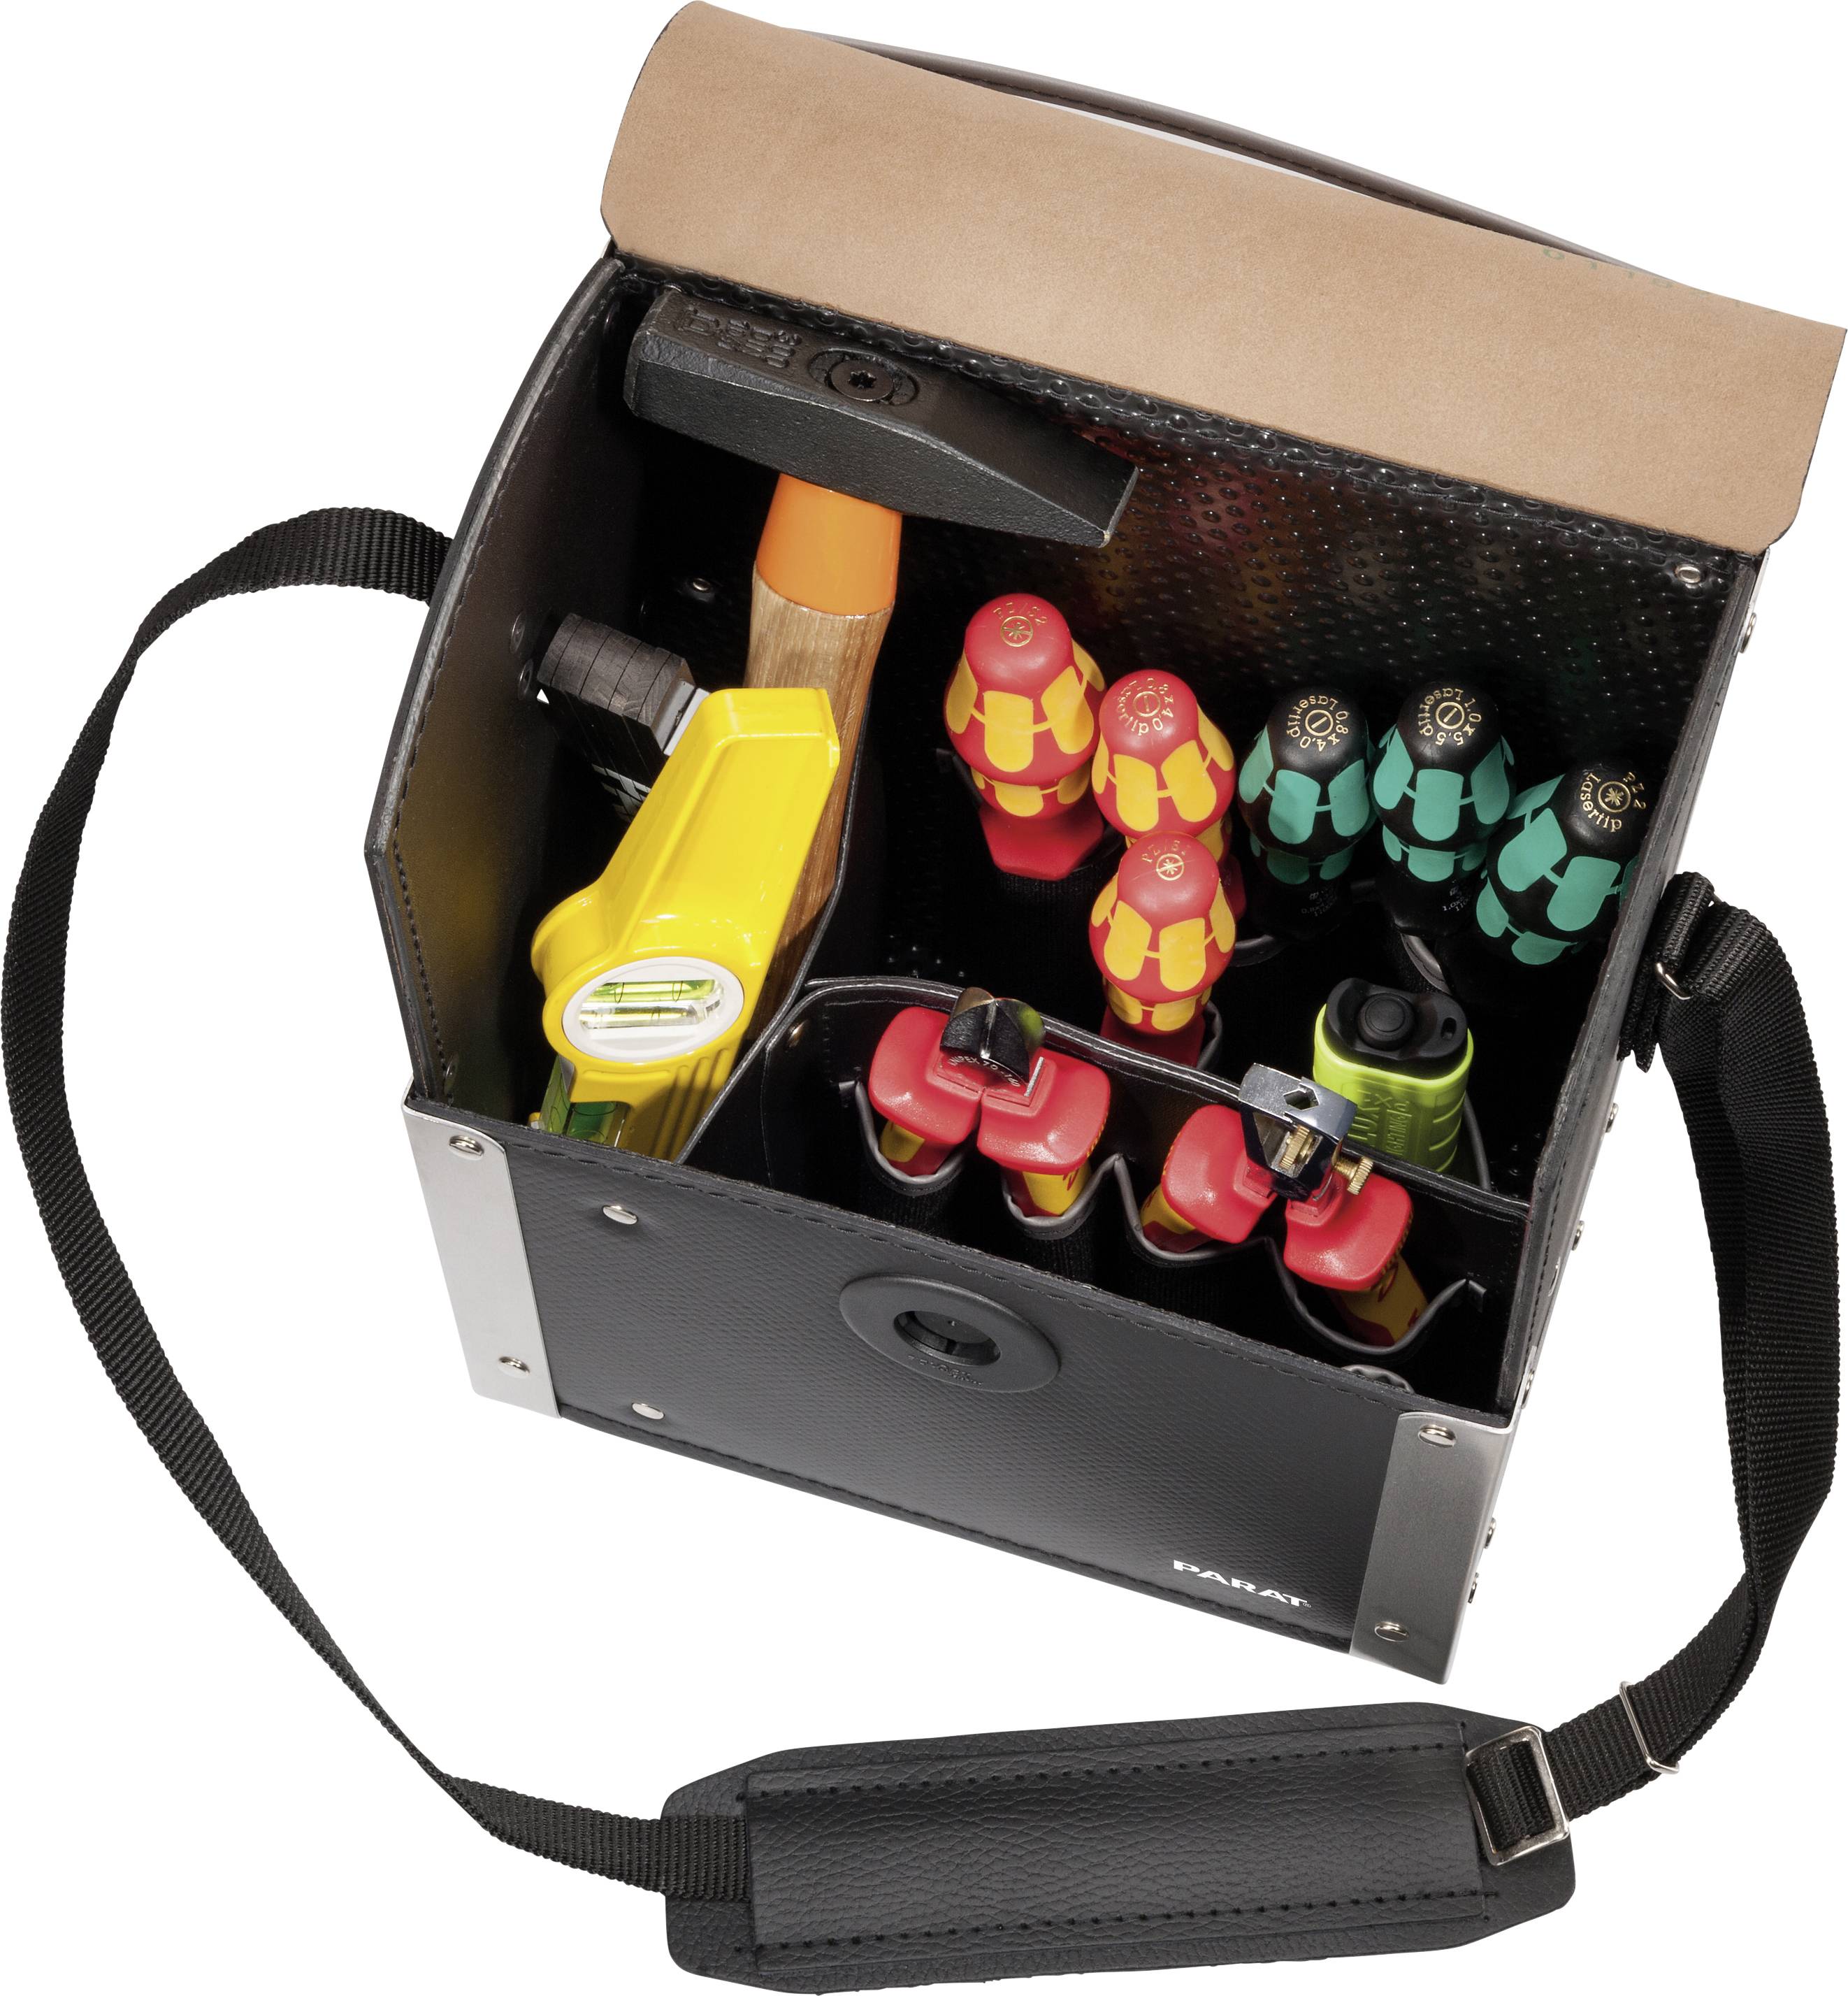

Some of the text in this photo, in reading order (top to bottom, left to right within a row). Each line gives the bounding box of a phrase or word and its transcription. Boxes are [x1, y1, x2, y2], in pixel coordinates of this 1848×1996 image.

[1285, 695, 1338, 738] Lasertip
[1417, 687, 1464, 737] Lasertip
[1580, 772, 1622, 833] Lasertip
